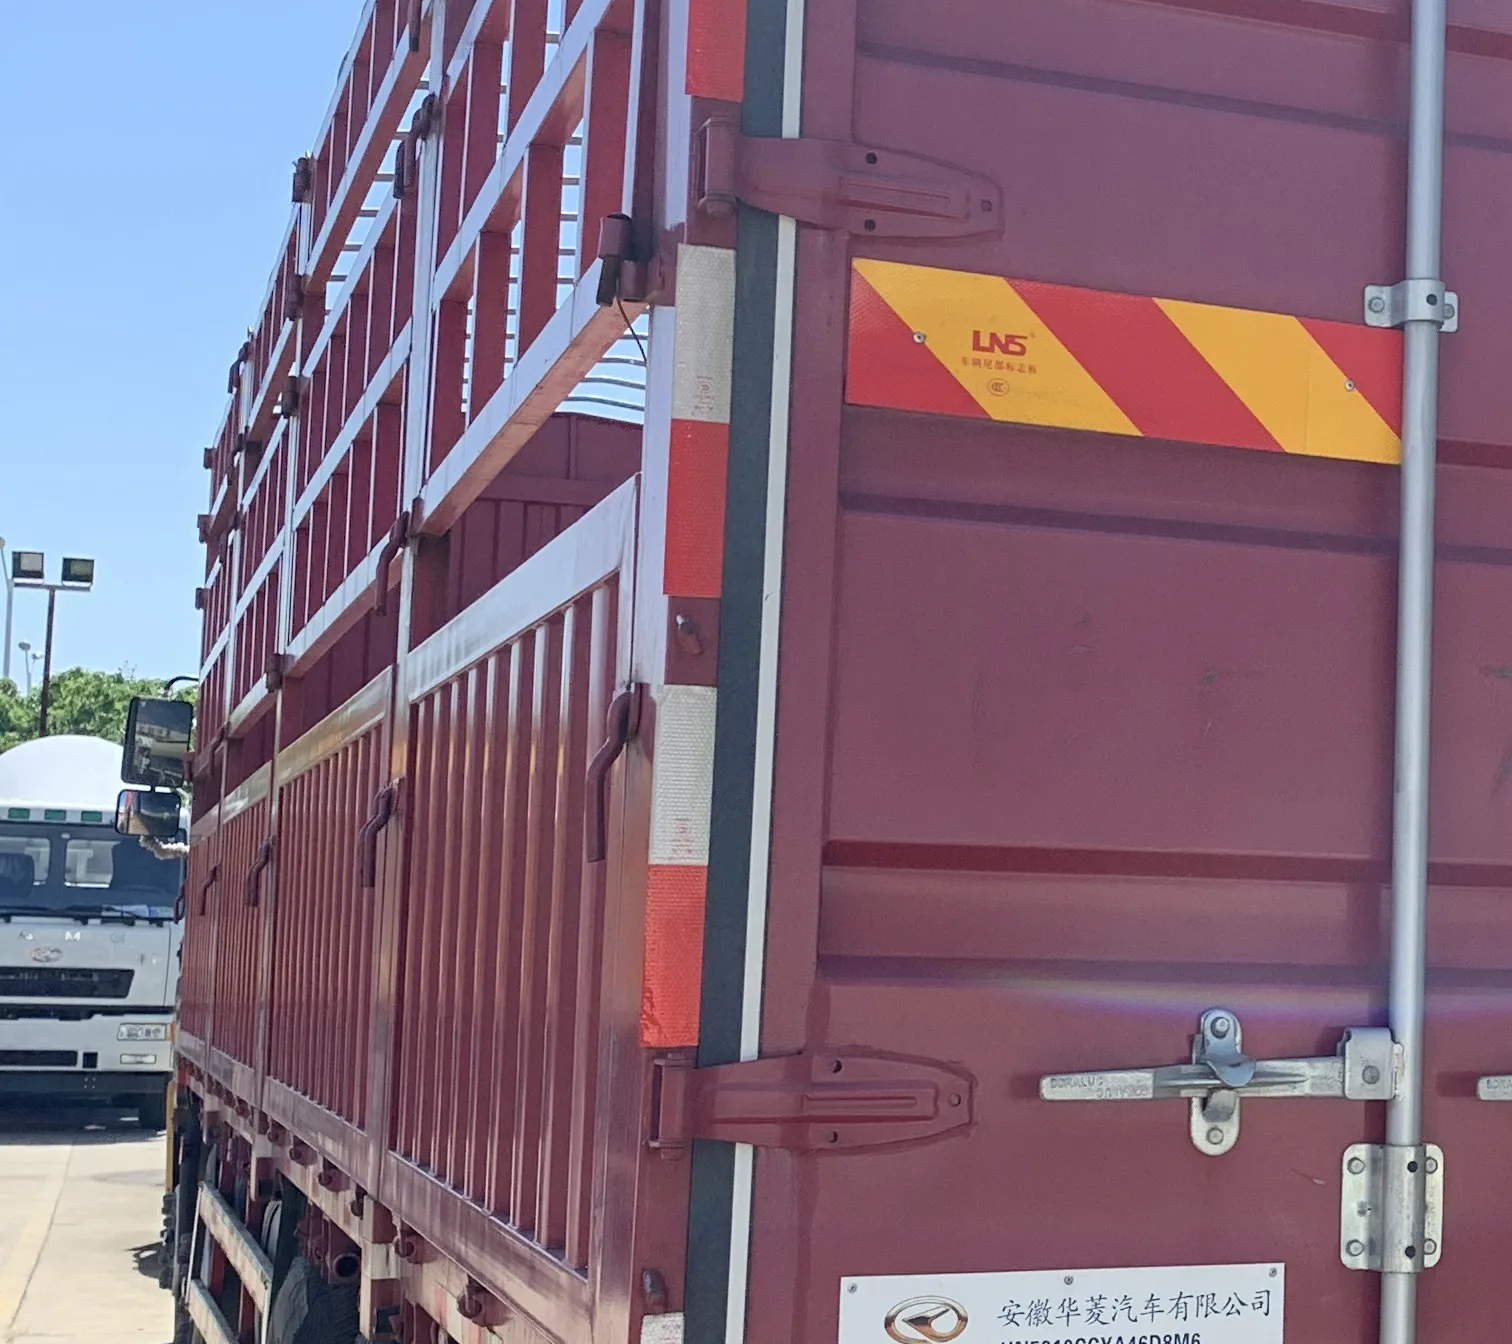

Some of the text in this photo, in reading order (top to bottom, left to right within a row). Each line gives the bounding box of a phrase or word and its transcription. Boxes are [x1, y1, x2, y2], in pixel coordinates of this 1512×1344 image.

[997, 1289, 1271, 1328] 安徽华菱汽车有限公司
